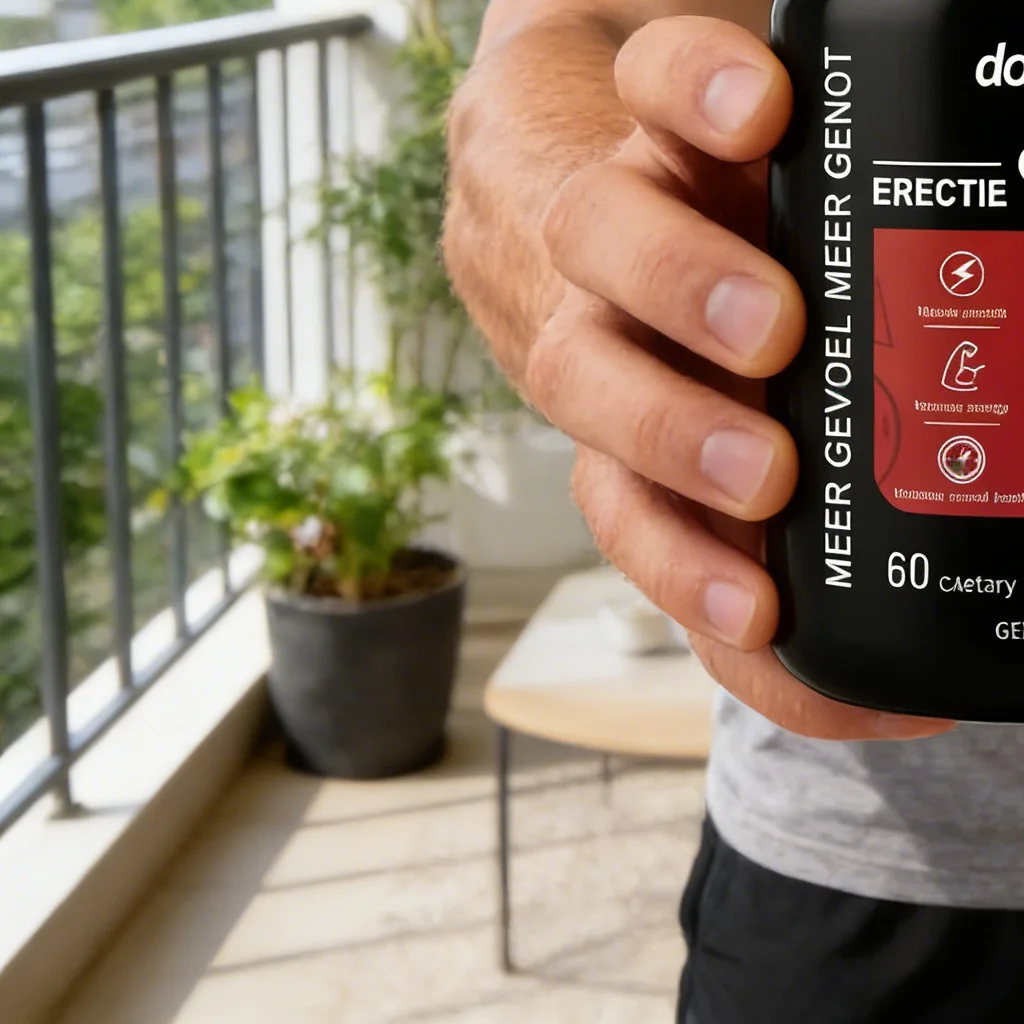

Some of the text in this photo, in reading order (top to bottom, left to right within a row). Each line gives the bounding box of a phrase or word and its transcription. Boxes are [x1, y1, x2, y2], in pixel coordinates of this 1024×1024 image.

[873, 177, 1007, 207] ERECTIE
[824, 47, 852, 589] MEER GEVOEL MEER GENOT
[888, 552, 929, 589] 60
